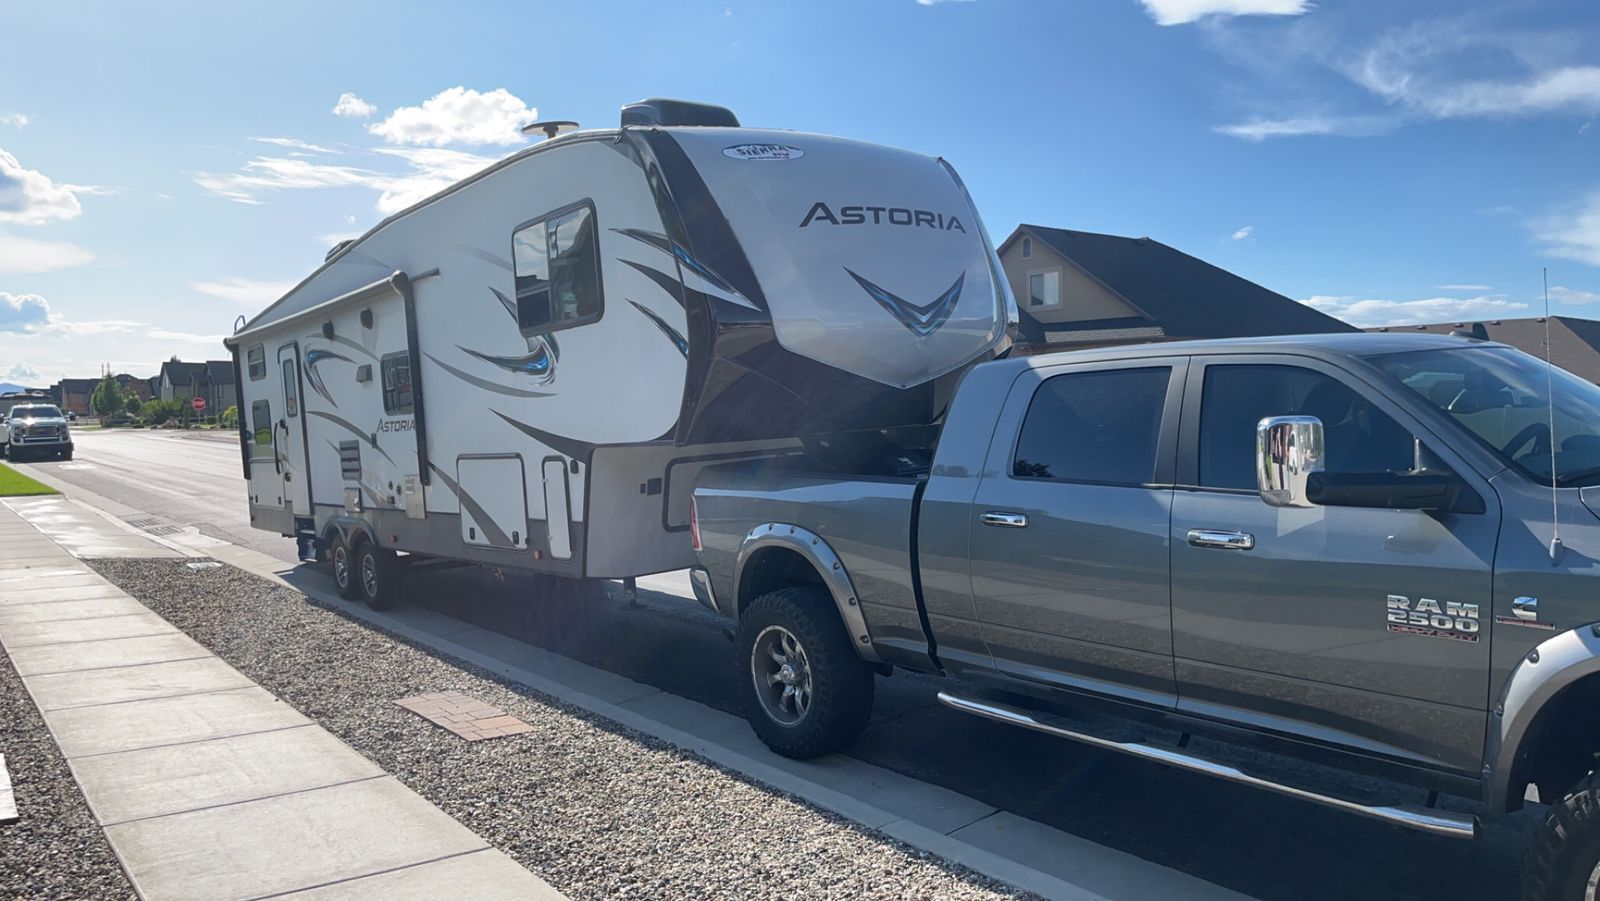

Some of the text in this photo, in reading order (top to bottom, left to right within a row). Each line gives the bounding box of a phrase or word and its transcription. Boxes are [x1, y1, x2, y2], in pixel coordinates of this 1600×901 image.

[736, 146, 789, 156] SIERRA
[799, 202, 967, 234] ASTORIA
[376, 418, 417, 433] ASTORIA
[1387, 594, 1479, 619] RAM
[1387, 608, 1479, 633] 2500
